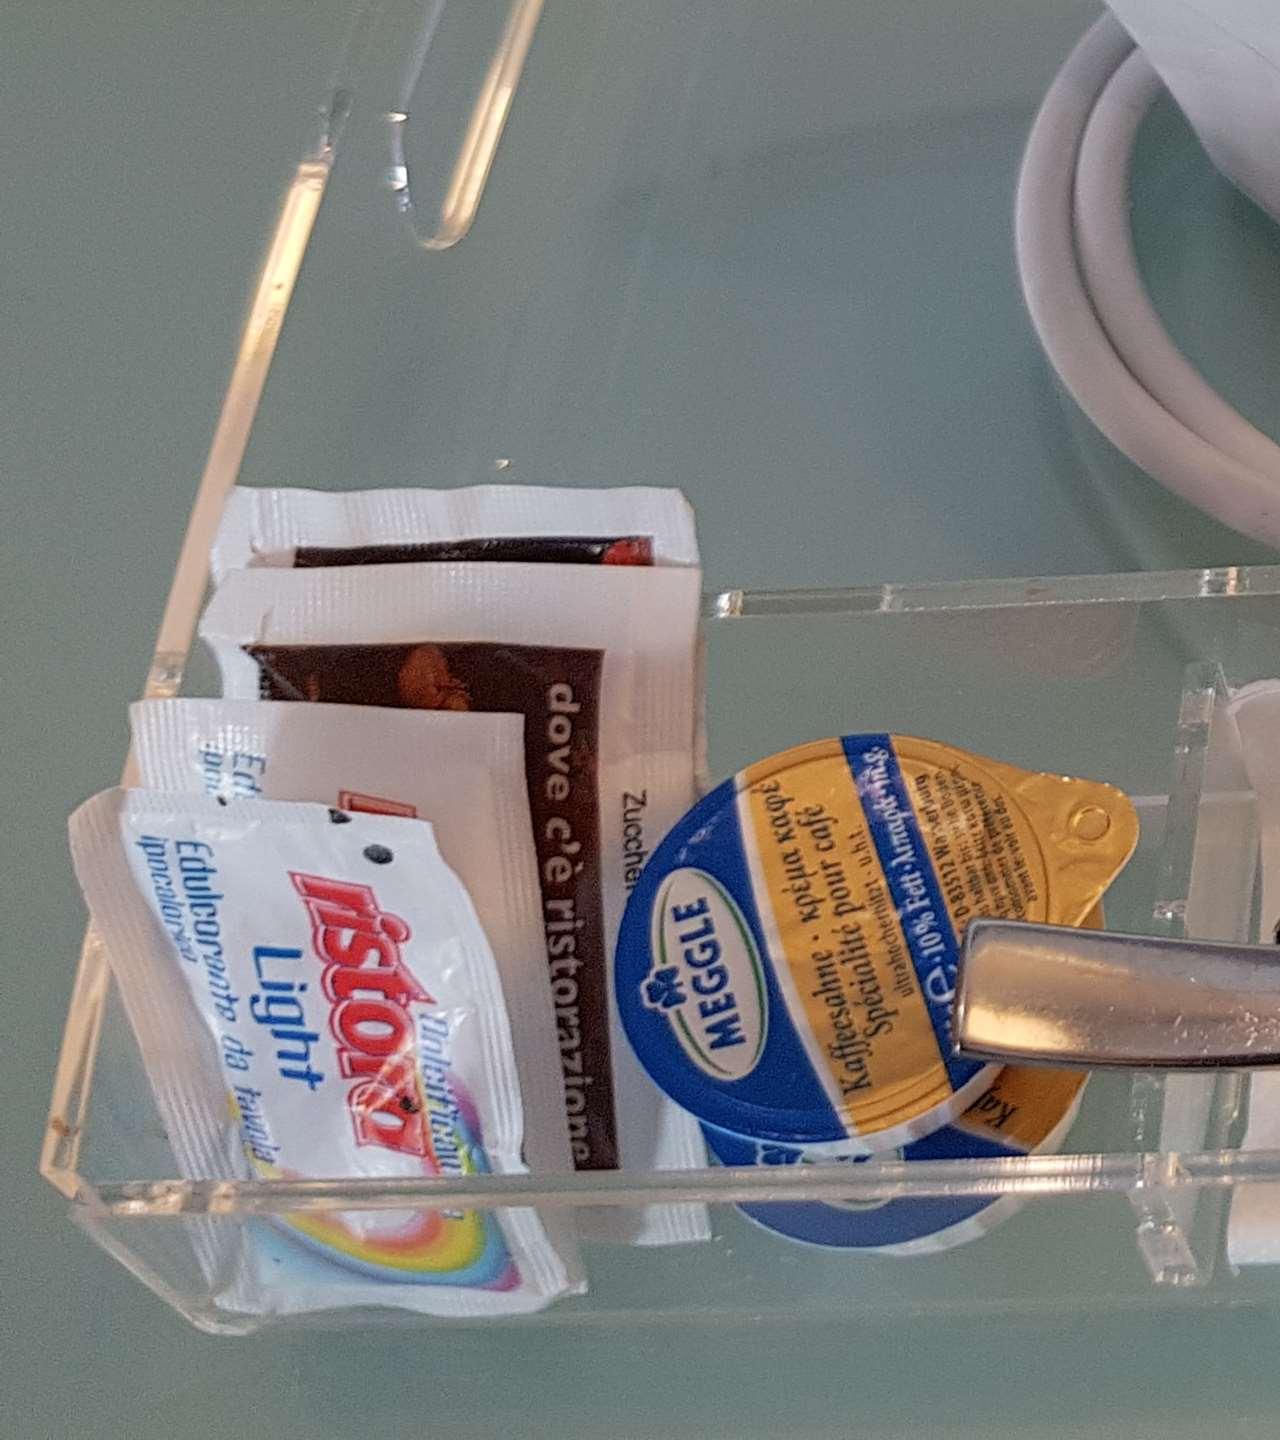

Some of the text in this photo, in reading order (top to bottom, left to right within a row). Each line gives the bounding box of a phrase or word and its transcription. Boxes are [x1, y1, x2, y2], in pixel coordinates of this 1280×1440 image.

[543, 682, 582, 802] dove
[174, 839, 238, 1023] Edulcorante
[219, 1033, 251, 1074] da
[672, 897, 746, 1051] MEGGLE
[800, 802, 900, 1039] Spécialité pour café
[250, 944, 325, 1092] Light
[546, 896, 590, 1163] ristorazione
[811, 949, 873, 1097] Kaffeesahne
